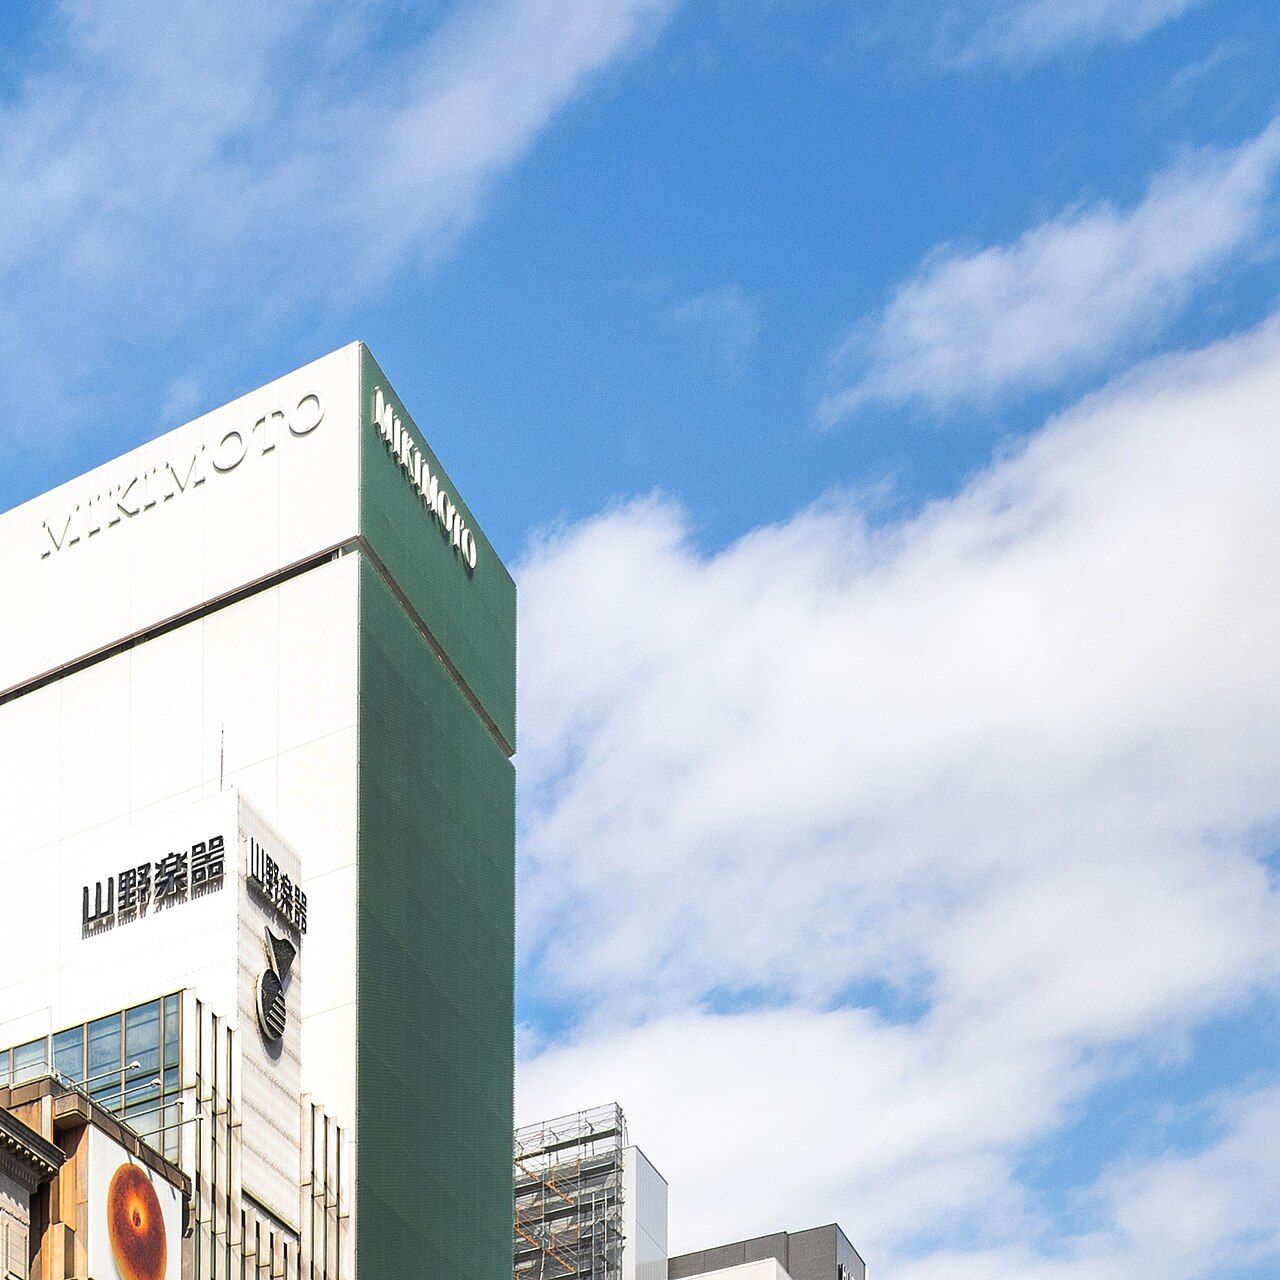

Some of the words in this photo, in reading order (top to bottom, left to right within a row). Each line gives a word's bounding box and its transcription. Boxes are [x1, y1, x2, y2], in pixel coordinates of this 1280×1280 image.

[41, 391, 327, 560] MIKIMOTO
[373, 386, 479, 570] MIKIMOTO
[81, 835, 225, 931] 山野楽器
[246, 836, 308, 935] 山野楽器
